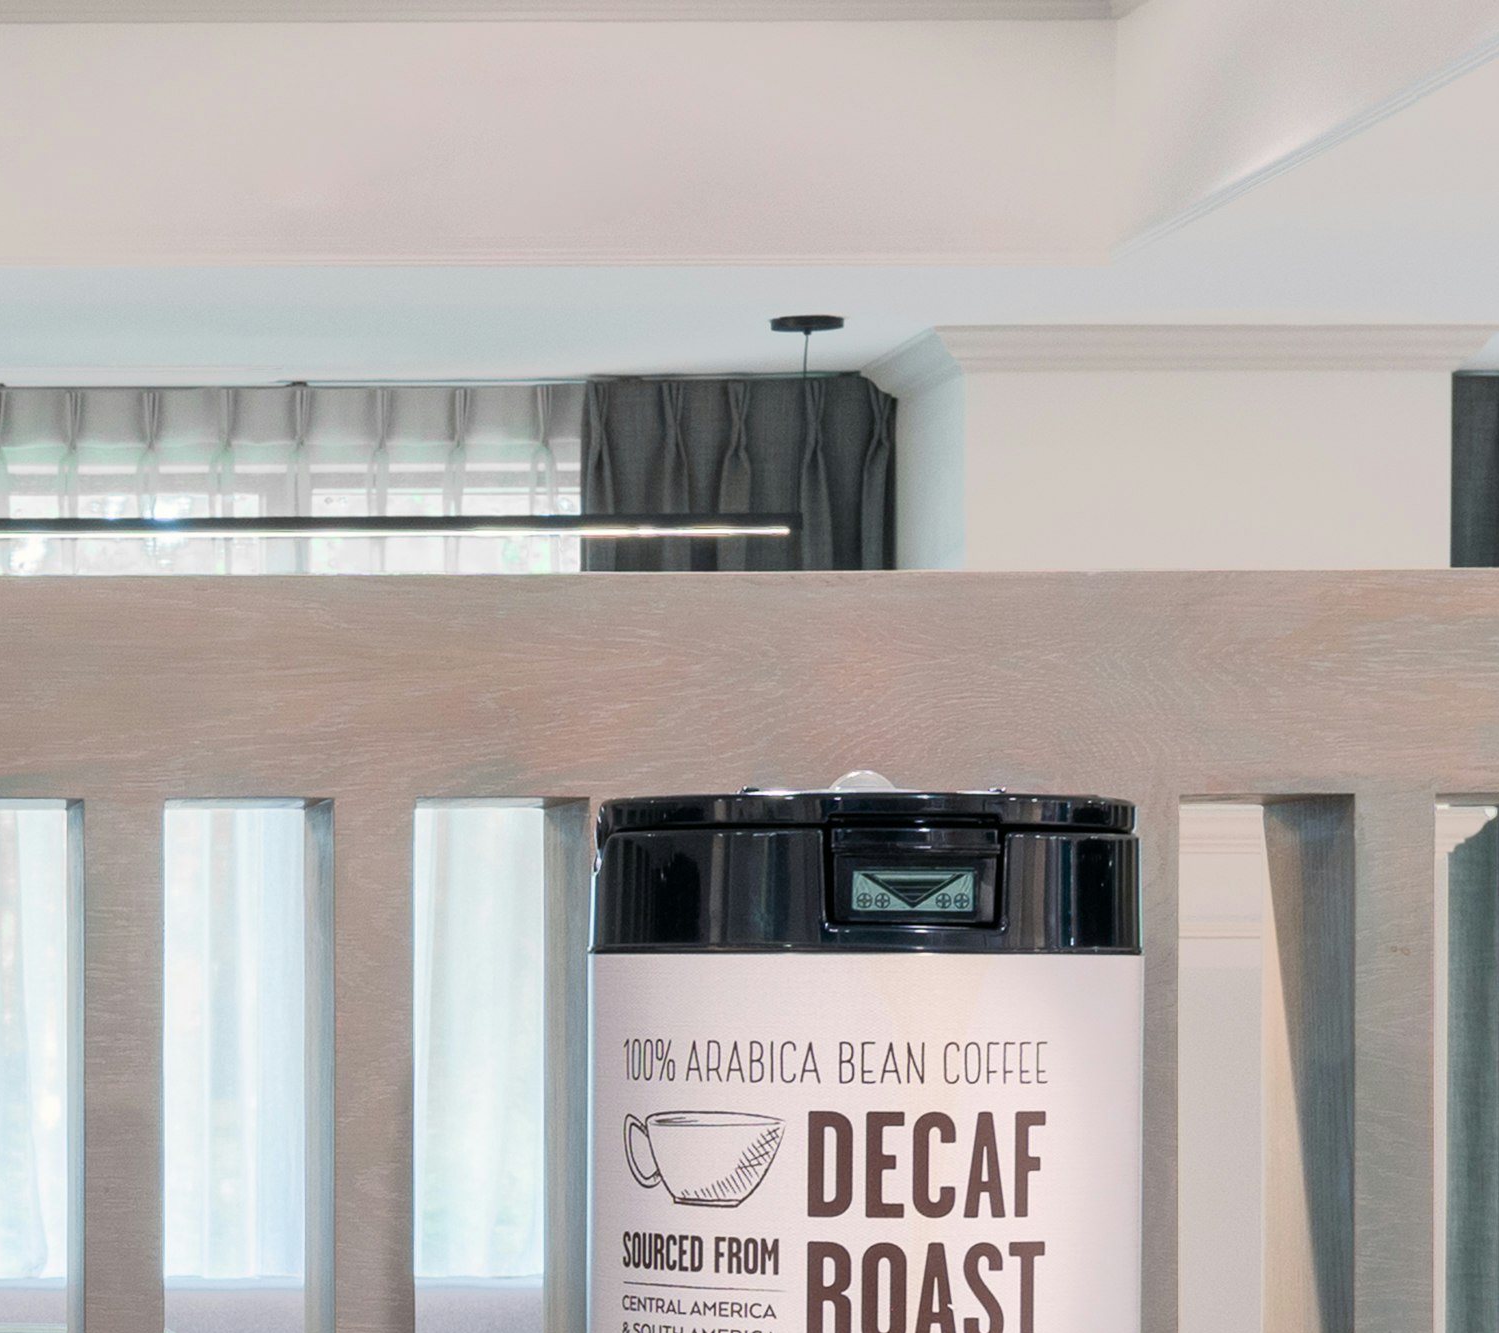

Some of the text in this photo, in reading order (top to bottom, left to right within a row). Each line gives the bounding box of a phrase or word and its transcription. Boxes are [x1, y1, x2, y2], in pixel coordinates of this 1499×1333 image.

[623, 1038, 1049, 1085] 100% ARABICA BEAN COFFEE
[807, 1110, 1047, 1219] DECAF
[623, 1231, 779, 1276] SOURCED FROM
[622, 1295, 777, 1320] CENTRAL AMERICA
